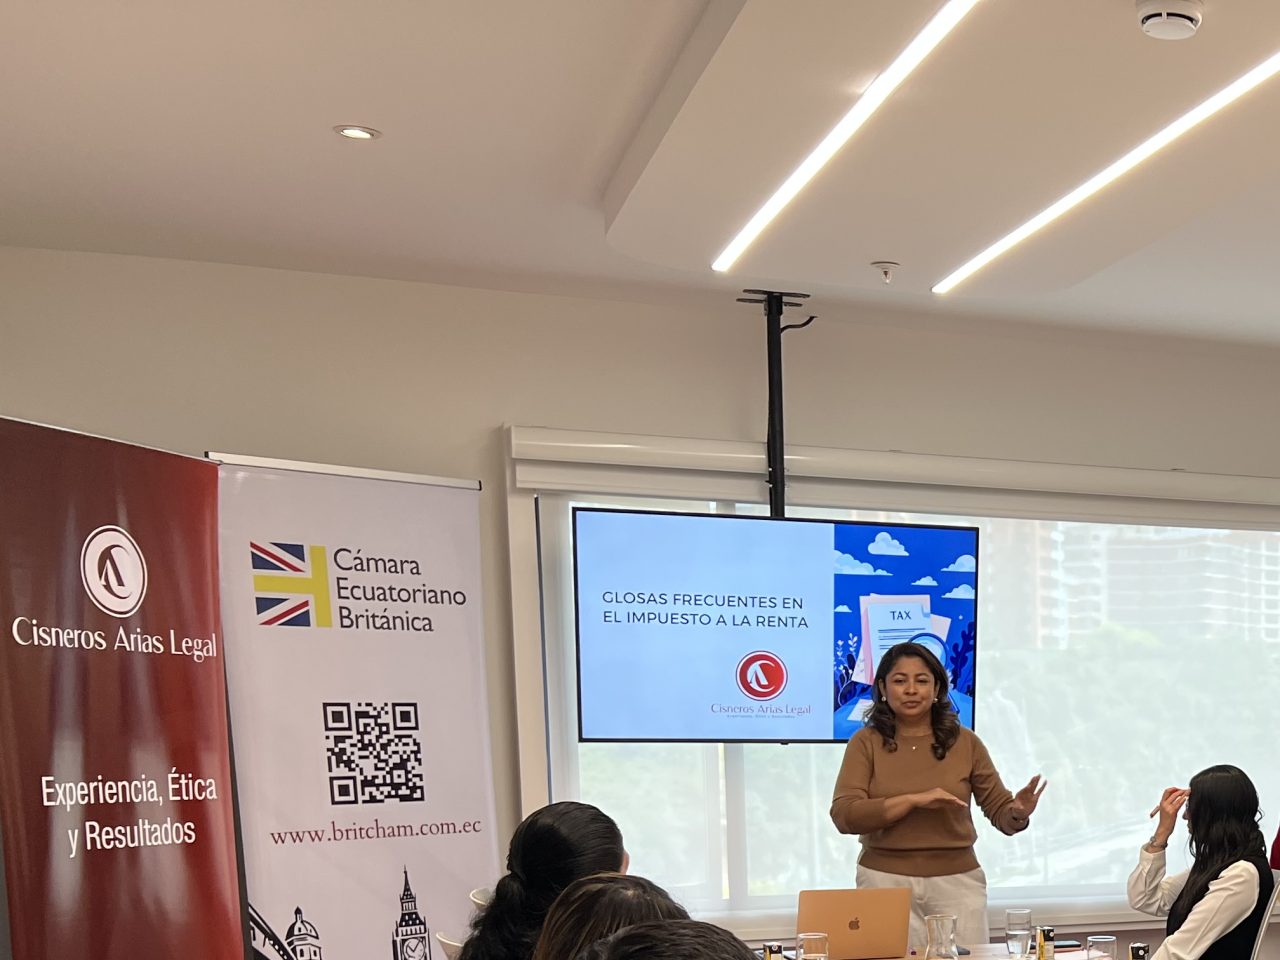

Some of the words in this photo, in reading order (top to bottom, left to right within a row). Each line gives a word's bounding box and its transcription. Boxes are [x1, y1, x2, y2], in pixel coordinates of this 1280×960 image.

[333, 547, 421, 576] Cámara
[336, 577, 467, 606] Ecuatoriano
[602, 591, 668, 605] GLOSAS
[673, 594, 778, 610] FRECUENTES
[782, 597, 804, 610] EN
[338, 605, 434, 632] Británica
[603, 611, 622, 624] EL
[627, 612, 712, 626] IMPUESTO
[716, 614, 728, 627] A
[732, 615, 752, 628] LA
[756, 616, 809, 630] RENTA
[889, 610, 912, 621] TAX
[12, 616, 107, 650] Cisneros
[114, 626, 164, 655] Arias
[170, 629, 217, 662] Legal
[711, 703, 754, 714] Cisneros
[758, 704, 783, 714] Arias
[786, 704, 811, 716] Legal
[42, 774, 163, 809] Experiencia,
[168, 767, 217, 801] Ética
[68, 829, 78, 857] y
[85, 818, 196, 851] Resultados
[270, 817, 482, 846] www.britcham.com.ec
